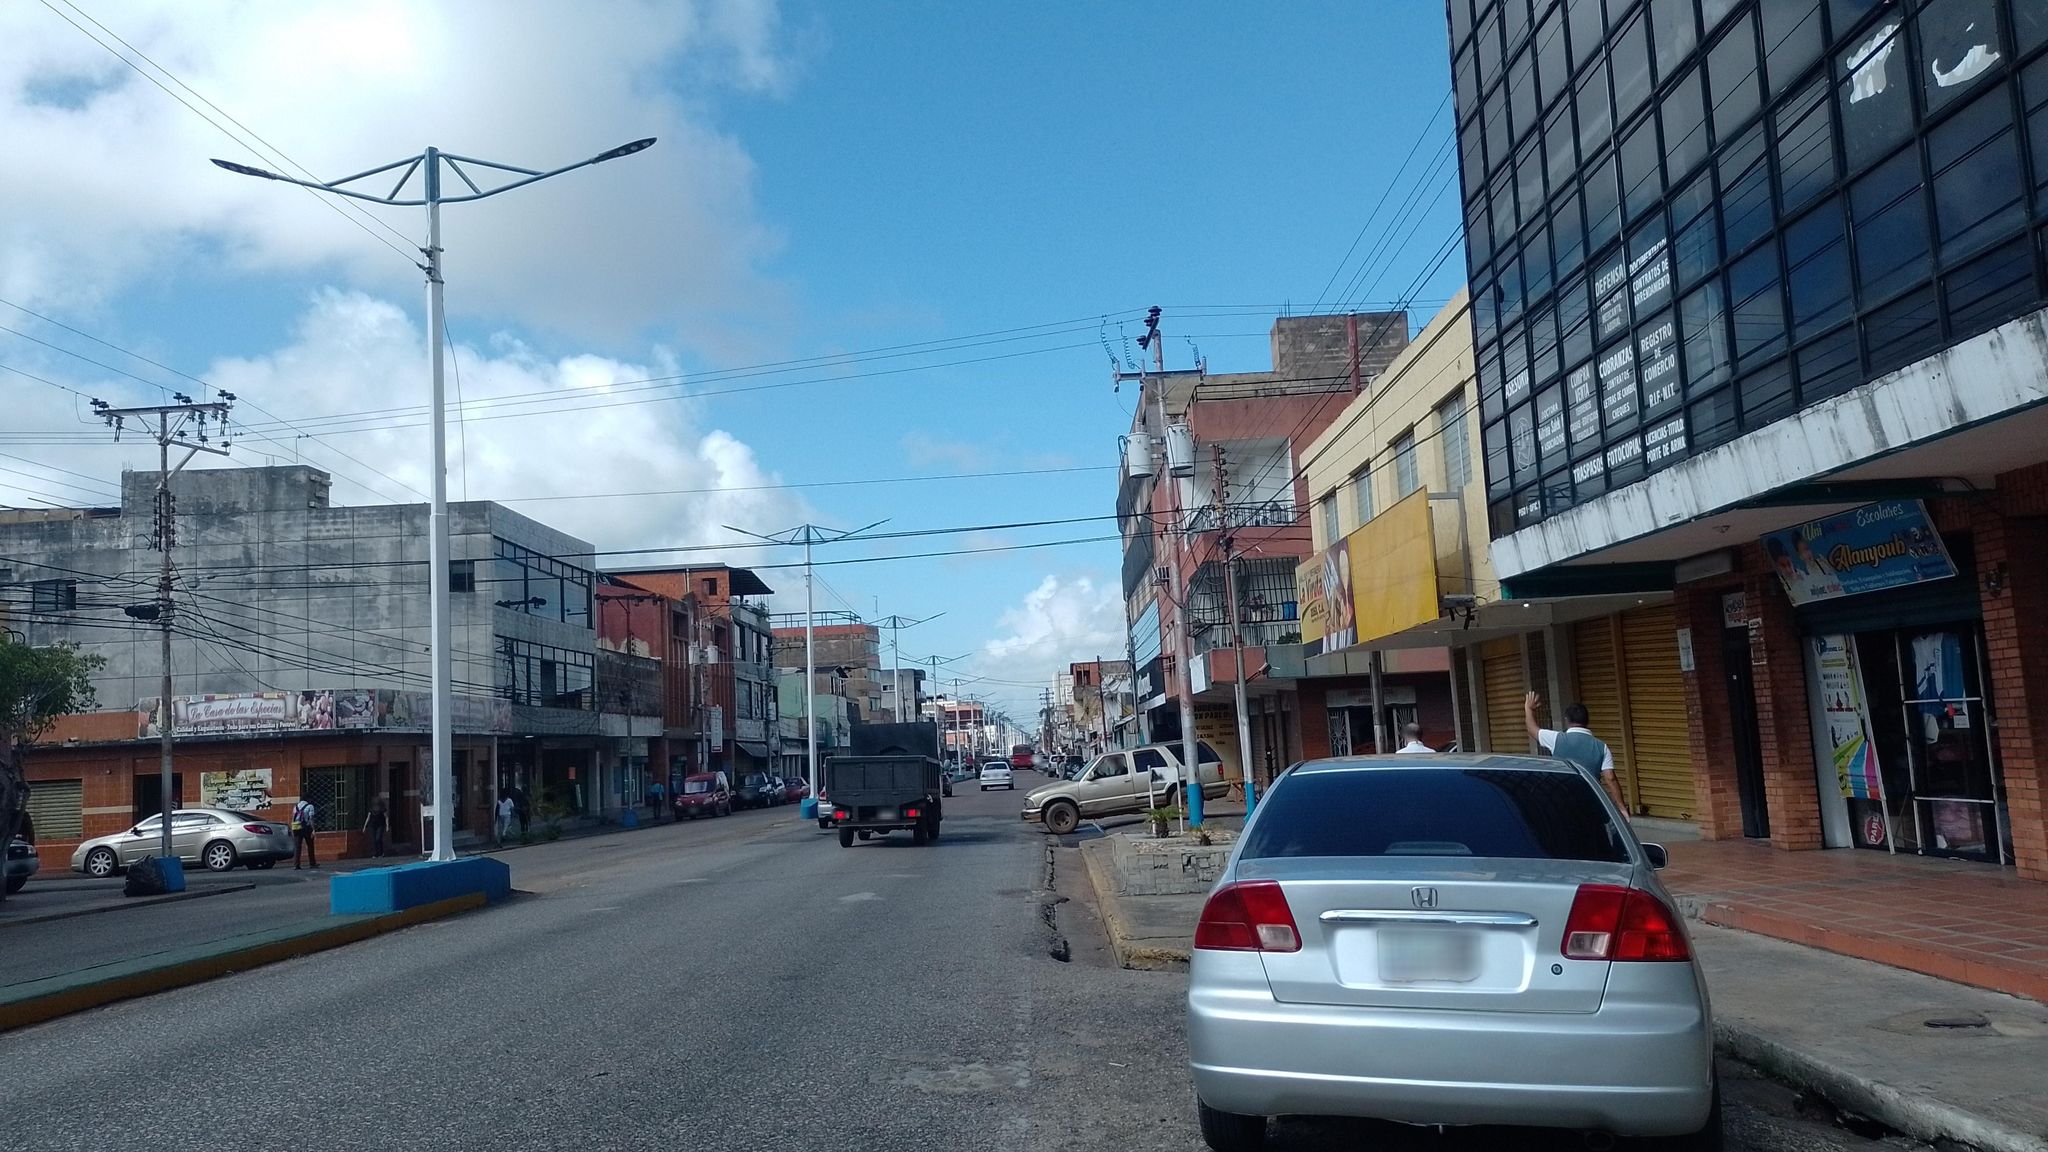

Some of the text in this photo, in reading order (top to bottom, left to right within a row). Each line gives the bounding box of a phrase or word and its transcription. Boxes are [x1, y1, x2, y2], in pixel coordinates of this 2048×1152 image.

[1595, 263, 1624, 297] DEFENSA
[1633, 258, 1669, 293] CONTRATOS DE
[1634, 273, 1670, 307] ARRENDAMIENTO
[1640, 322, 1672, 353] REGISTRO
[1599, 345, 1633, 378] COBRANZAS
[1654, 346, 1661, 359] DE
[1570, 365, 1590, 388] COMPRA
[1606, 369, 1630, 390] CONTRATOS
[1644, 353, 1675, 383] COMERCIO
[1575, 382, 1590, 404] VENTA
[1611, 402, 1630, 420] CHEQUES
[1646, 446, 1662, 464] PORTE
[1662, 443, 1670, 457] DE
[1856, 502, 1904, 526] Escolares
[190, 701, 283, 721] La Casa de las Especias
[1870, 815, 1883, 842] PARE
